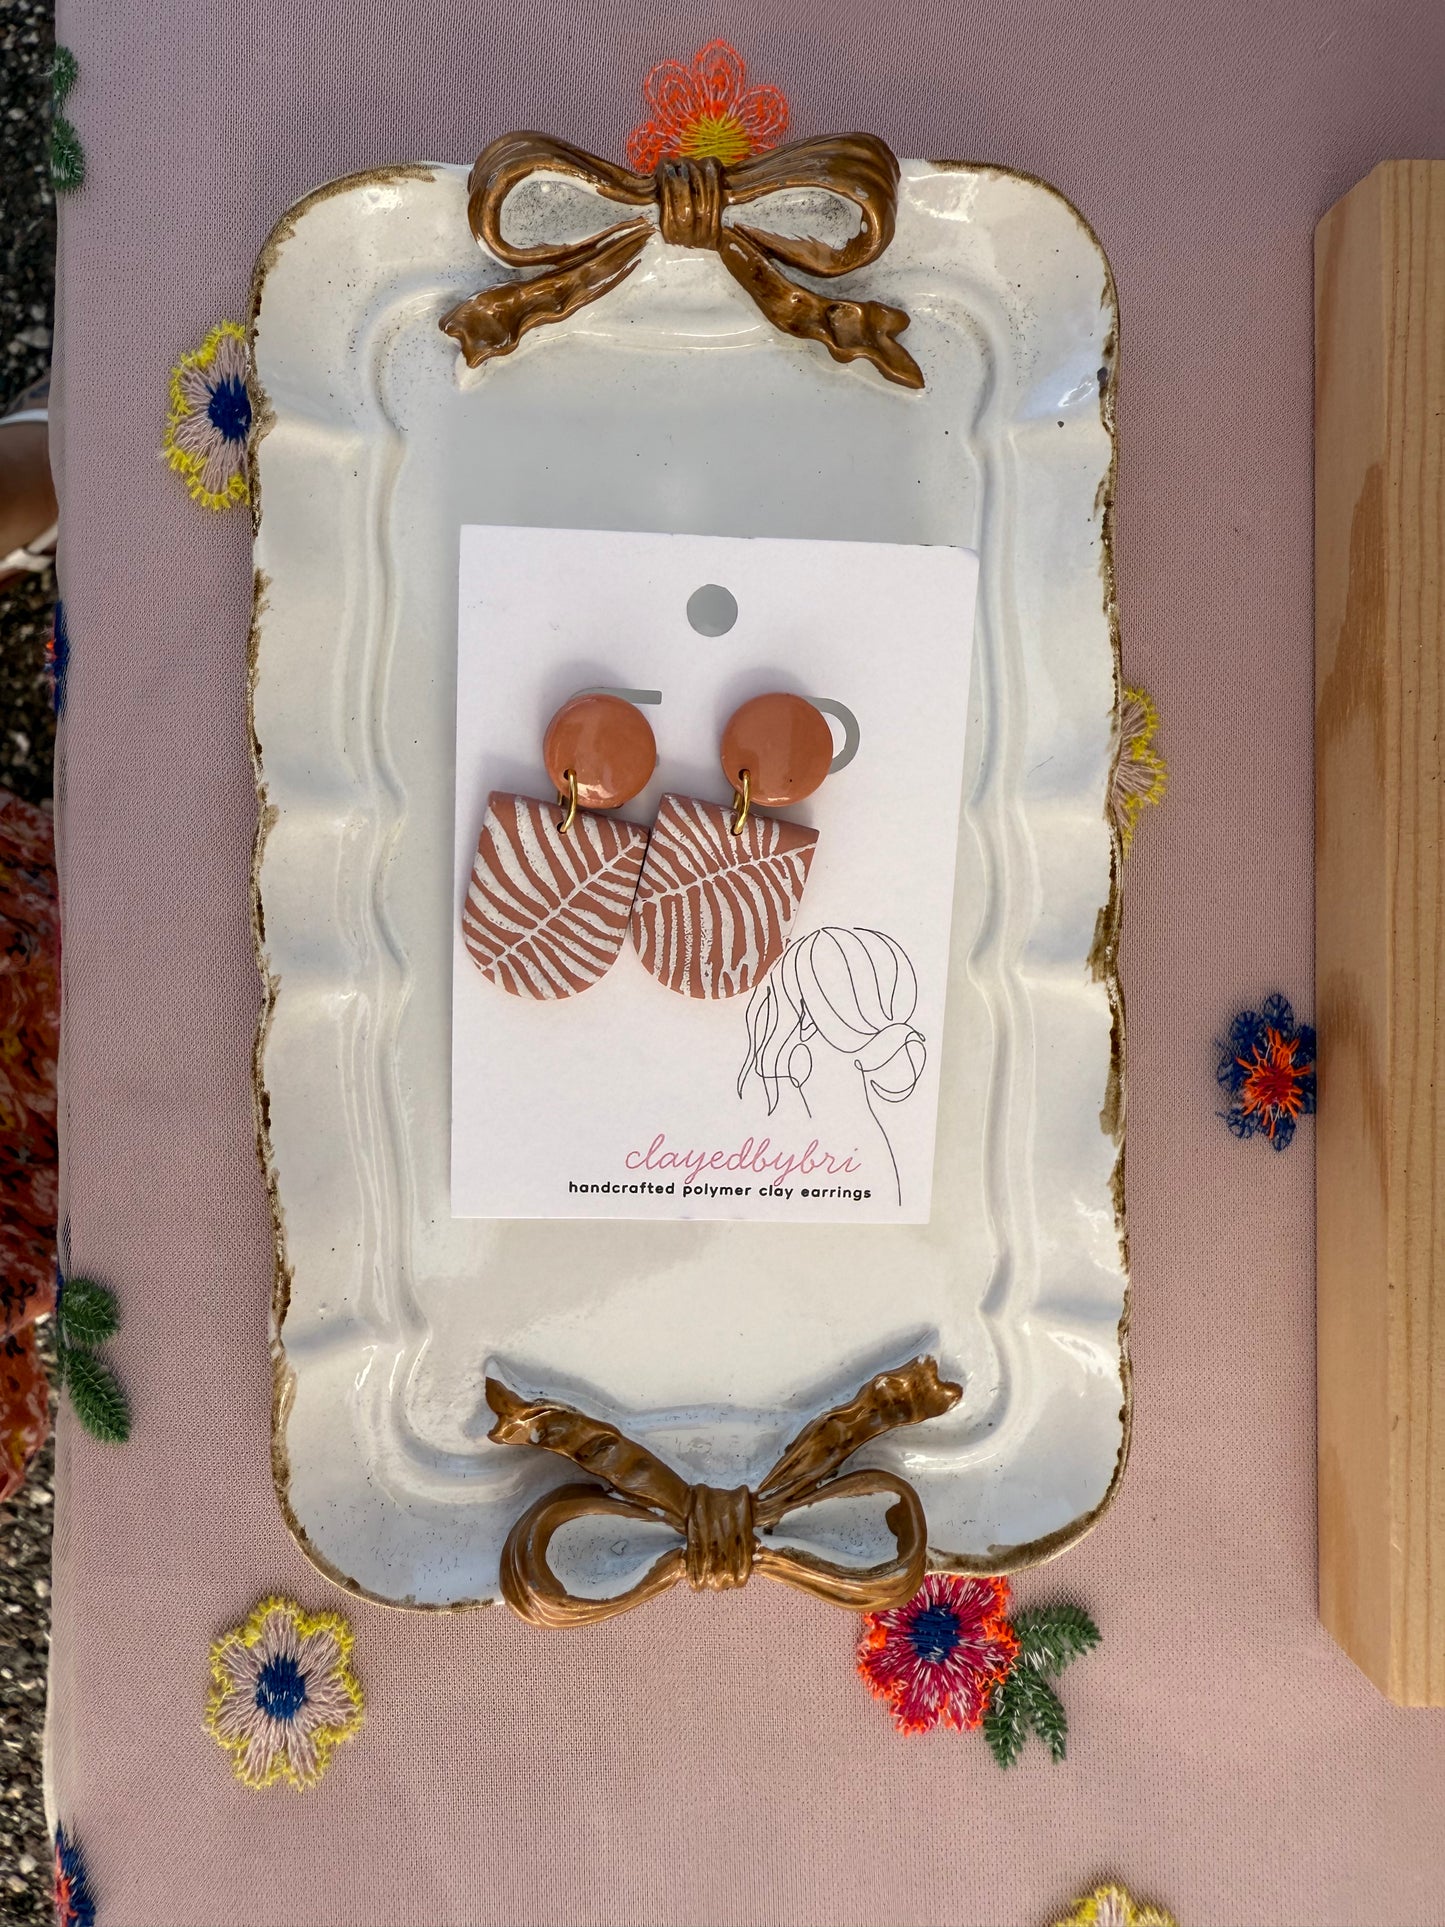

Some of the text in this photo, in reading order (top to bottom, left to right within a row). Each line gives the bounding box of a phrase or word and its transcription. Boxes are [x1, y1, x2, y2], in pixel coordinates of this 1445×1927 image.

[624, 1133, 862, 1186] clayedbybri
[568, 1181, 872, 1201] handcrafted polymer clay earrings
